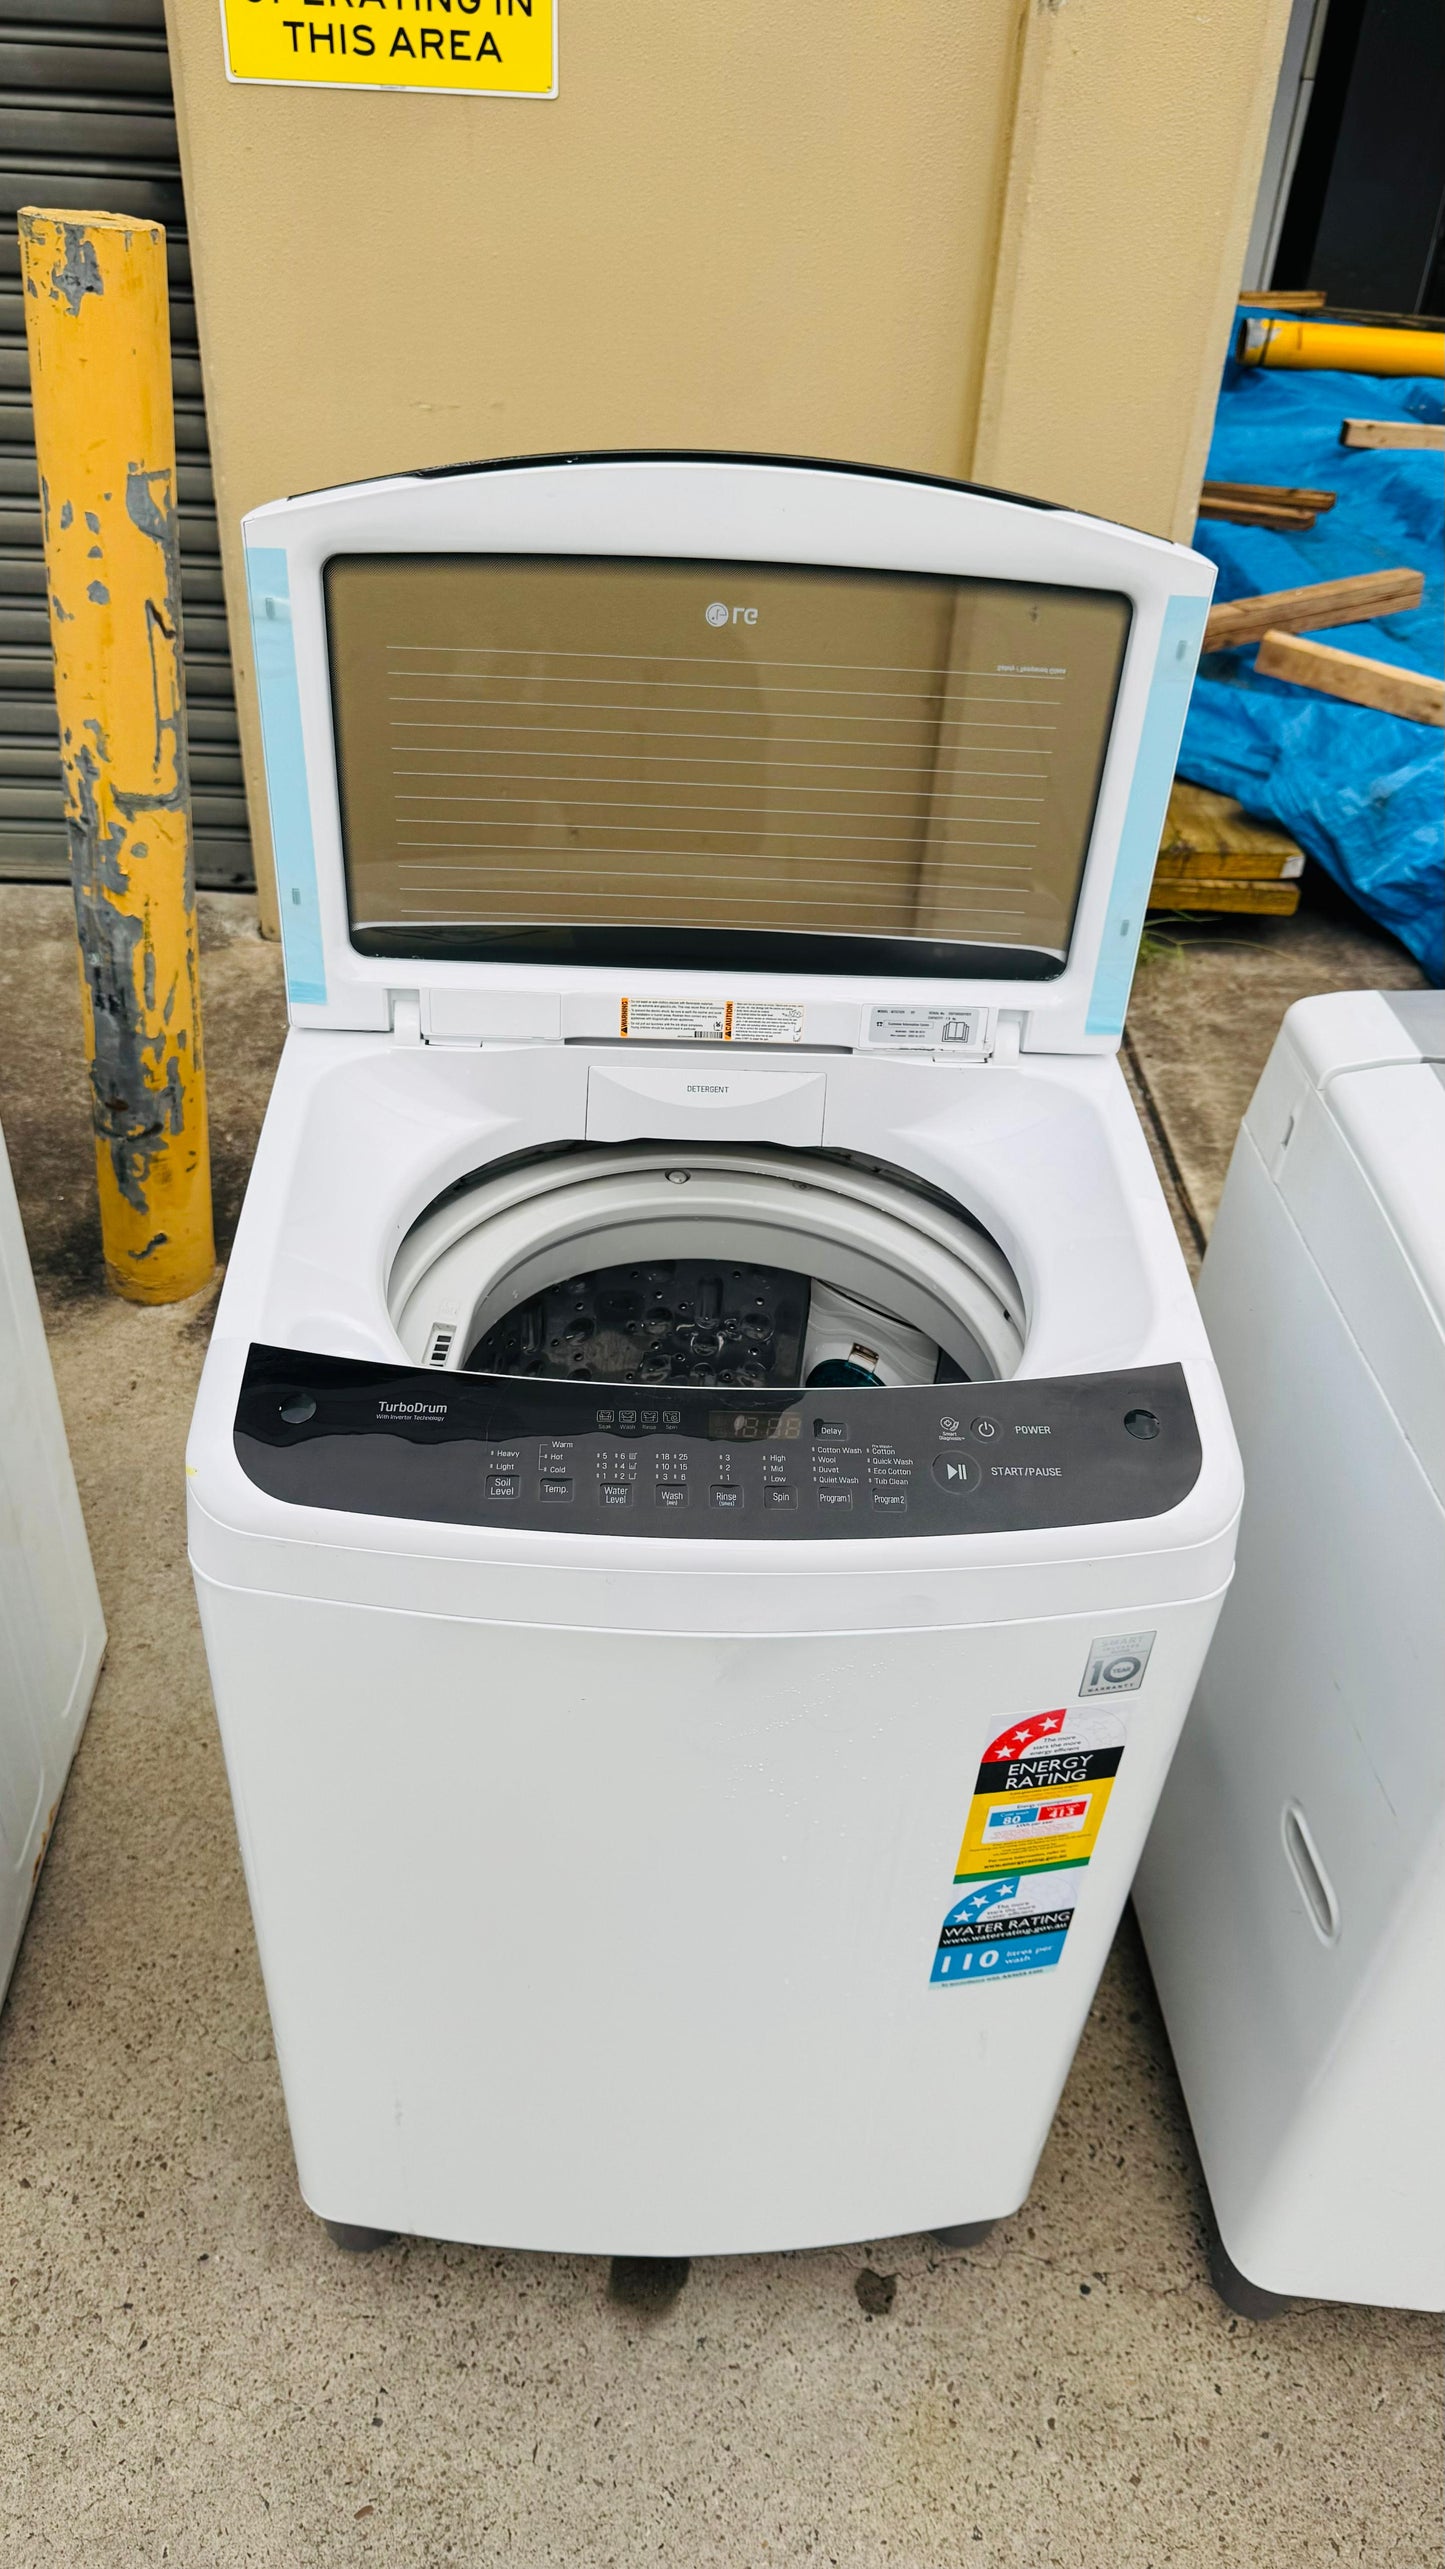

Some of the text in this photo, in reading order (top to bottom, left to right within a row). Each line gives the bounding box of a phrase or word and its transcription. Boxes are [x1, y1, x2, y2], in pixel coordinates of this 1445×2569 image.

[283, 21, 503, 63] THIS AREA
[725, 1003, 733, 1031] CAUTION
[687, 1085, 729, 1093] DETERGENT
[378, 1401, 448, 1413] TurboDrum
[414, 1414, 445, 1422] Technology
[821, 1426, 842, 1436] Delay
[1015, 1426, 1051, 1434] POWER
[497, 1450, 520, 1458] Heavy
[818, 1446, 840, 1454] Cotton
[602, 1452, 608, 1460] 5
[770, 1454, 786, 1462] High
[496, 1463, 514, 1471] Light
[602, 1462, 625, 1470] 3 4
[726, 1464, 730, 1472] 2
[620, 1472, 625, 1480] 2
[888, 1468, 912, 1476] Cotton
[991, 1467, 1062, 1476] START/PAUSE
[494, 1478, 511, 1487] Soil
[820, 1476, 837, 1484] Quiet
[490, 1486, 514, 1496] Level
[544, 1484, 569, 1494] Temp.
[604, 1486, 628, 1494] Water
[606, 1494, 626, 1504] Level
[661, 1491, 684, 1500] Wash
[716, 1492, 737, 1500] Rinse
[772, 1492, 790, 1502] Spin
[820, 1494, 846, 1504] Program
[874, 1494, 900, 1504] Program
[1090, 1657, 1141, 1686] 10
[1008, 1754, 1094, 1776] ENERGY
[1005, 1768, 1088, 1790] RATING
[1049, 1808, 1075, 1818] 413
[1002, 1816, 1022, 1825] 80
[944, 1912, 1071, 1937] WATER RATING
[1006, 1946, 1052, 1957] litres per
[941, 1949, 999, 1974] 110
[1005, 1955, 1031, 1964] wash
